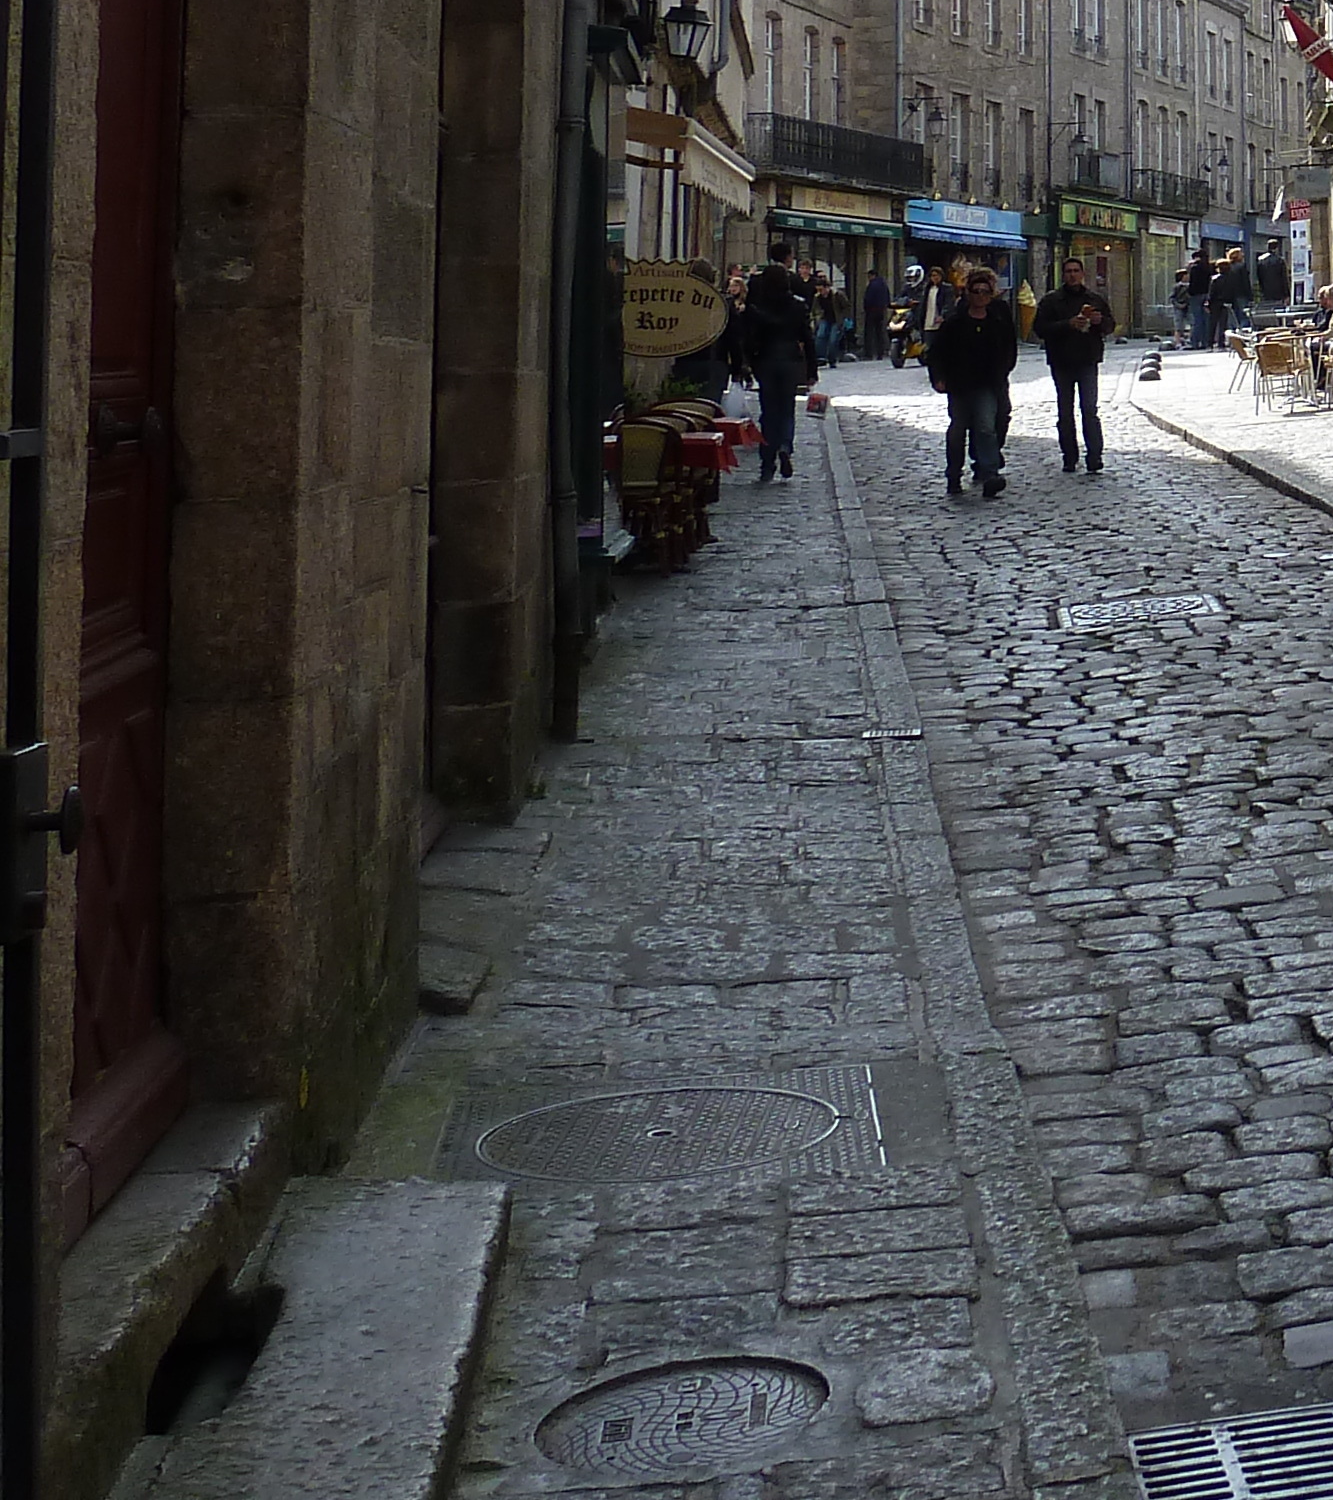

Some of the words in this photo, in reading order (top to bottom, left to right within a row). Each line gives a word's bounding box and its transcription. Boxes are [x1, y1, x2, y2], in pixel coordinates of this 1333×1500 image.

[634, 266, 684, 278] Artisan
[691, 288, 716, 310] du
[635, 311, 679, 334] Roy
